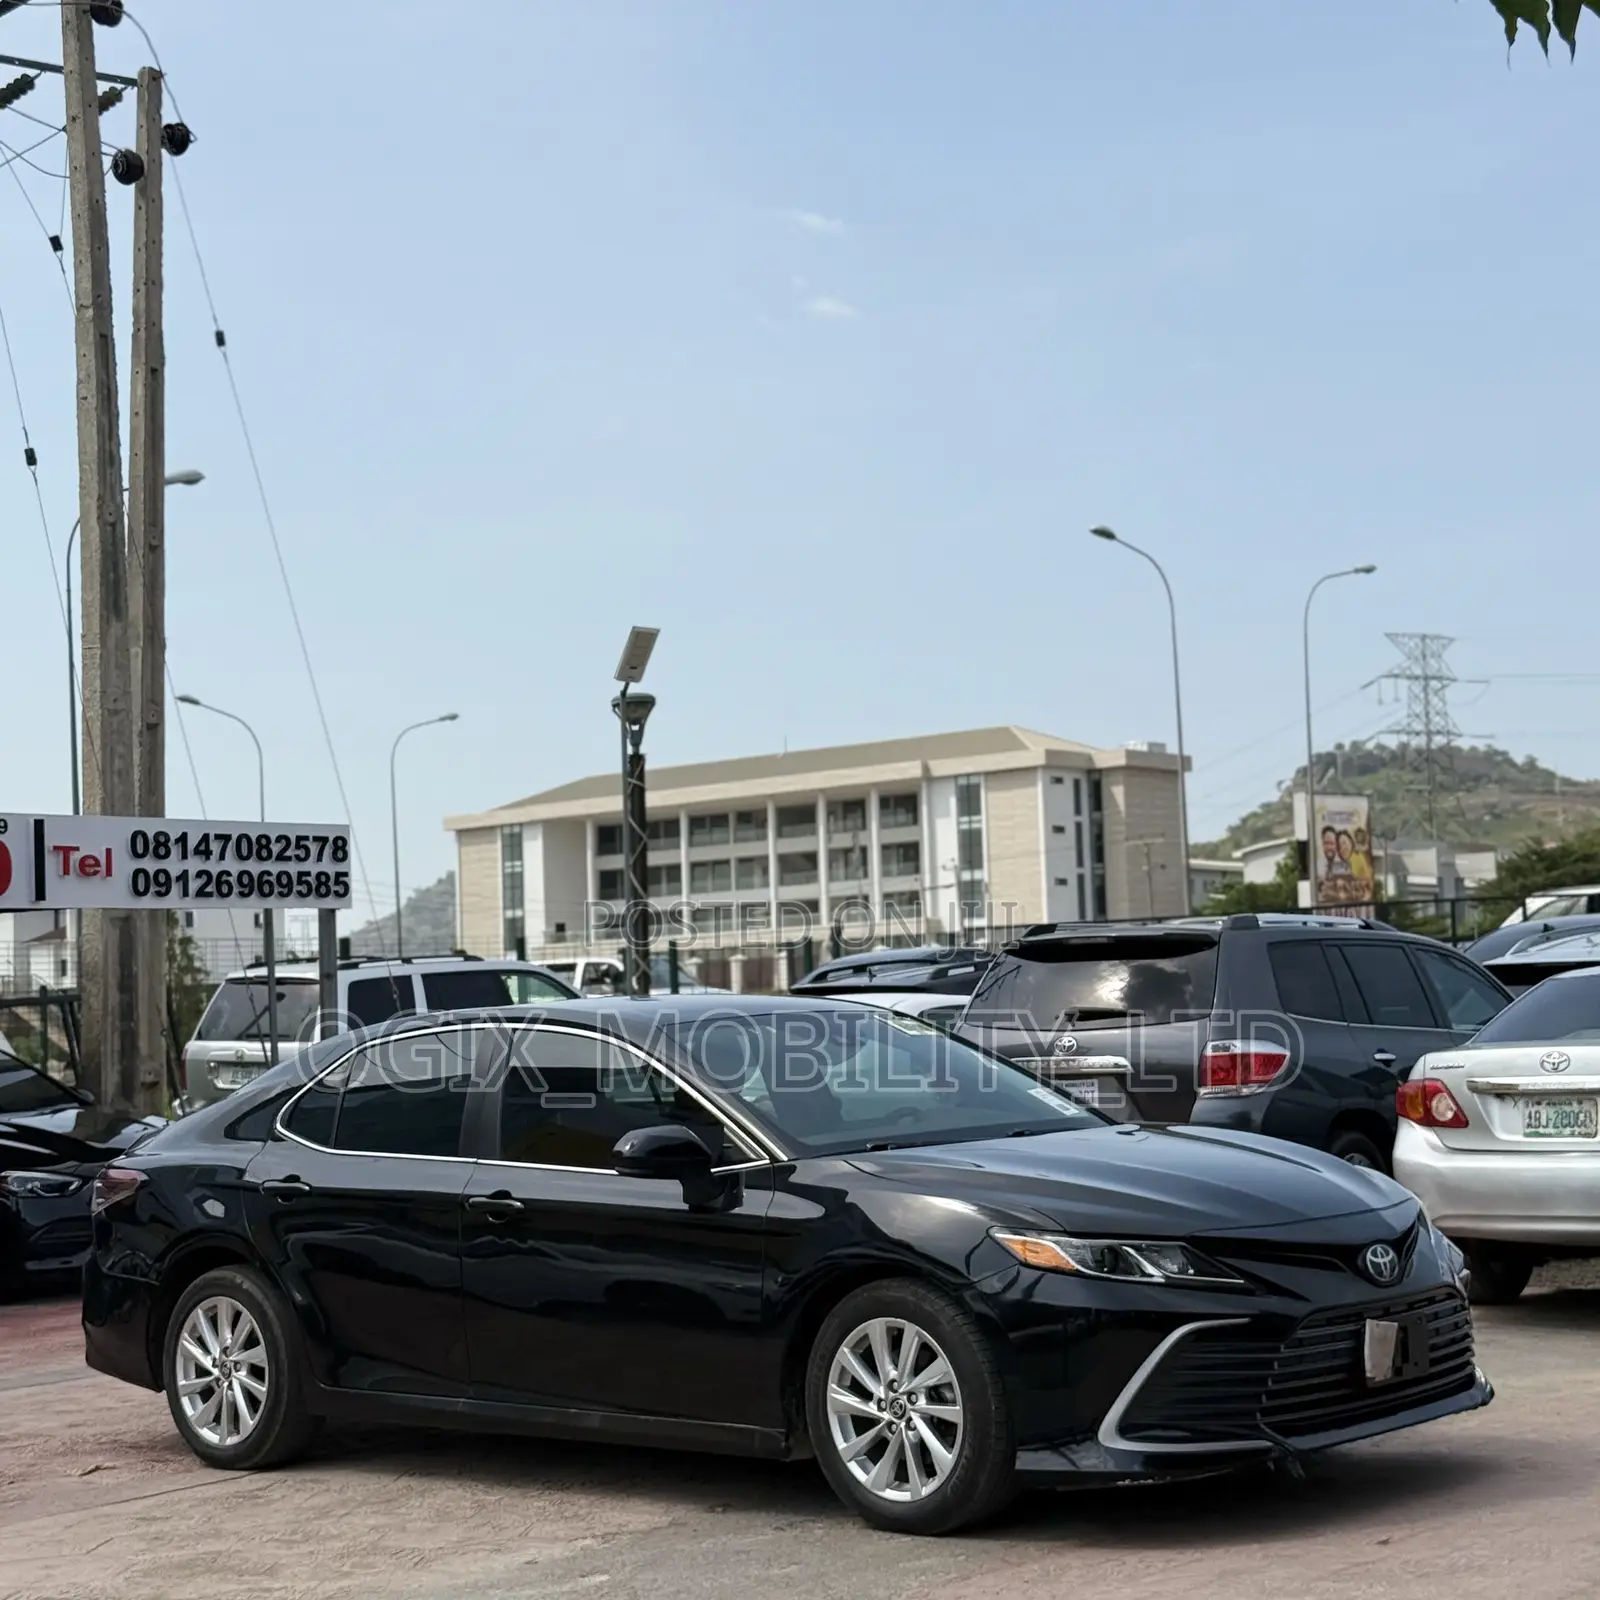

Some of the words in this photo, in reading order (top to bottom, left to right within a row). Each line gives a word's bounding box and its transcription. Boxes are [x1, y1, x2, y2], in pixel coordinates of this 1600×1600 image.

[53, 845, 113, 877] Tel
[130, 829, 349, 862] 08147082578
[131, 867, 350, 898] 09126969585
